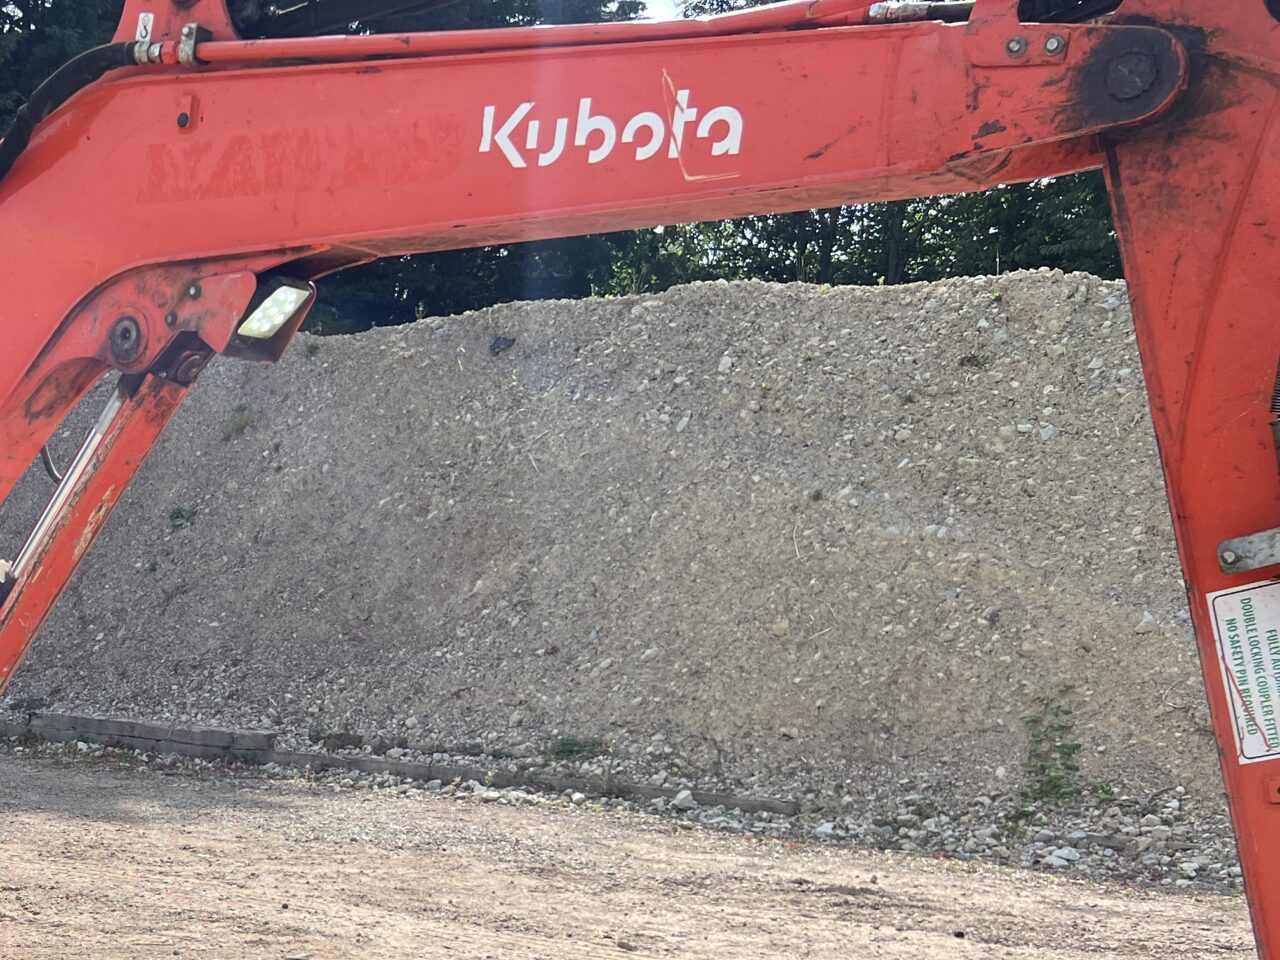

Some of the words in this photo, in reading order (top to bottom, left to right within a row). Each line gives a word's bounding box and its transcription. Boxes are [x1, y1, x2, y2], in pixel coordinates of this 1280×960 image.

[478, 88, 744, 168] Kubota
[1225, 618, 1238, 632] NO
[1240, 597, 1258, 634] DOUBLE
[1228, 634, 1245, 667] SAFETY
[1248, 635, 1266, 675] LOCKING
[1266, 629, 1280, 656] FULLY
[1235, 668, 1248, 687] PIN
[1240, 687, 1258, 735] REQUIRED
[1256, 676, 1274, 716] COUPLER
[1264, 717, 1280, 749] FITTED
